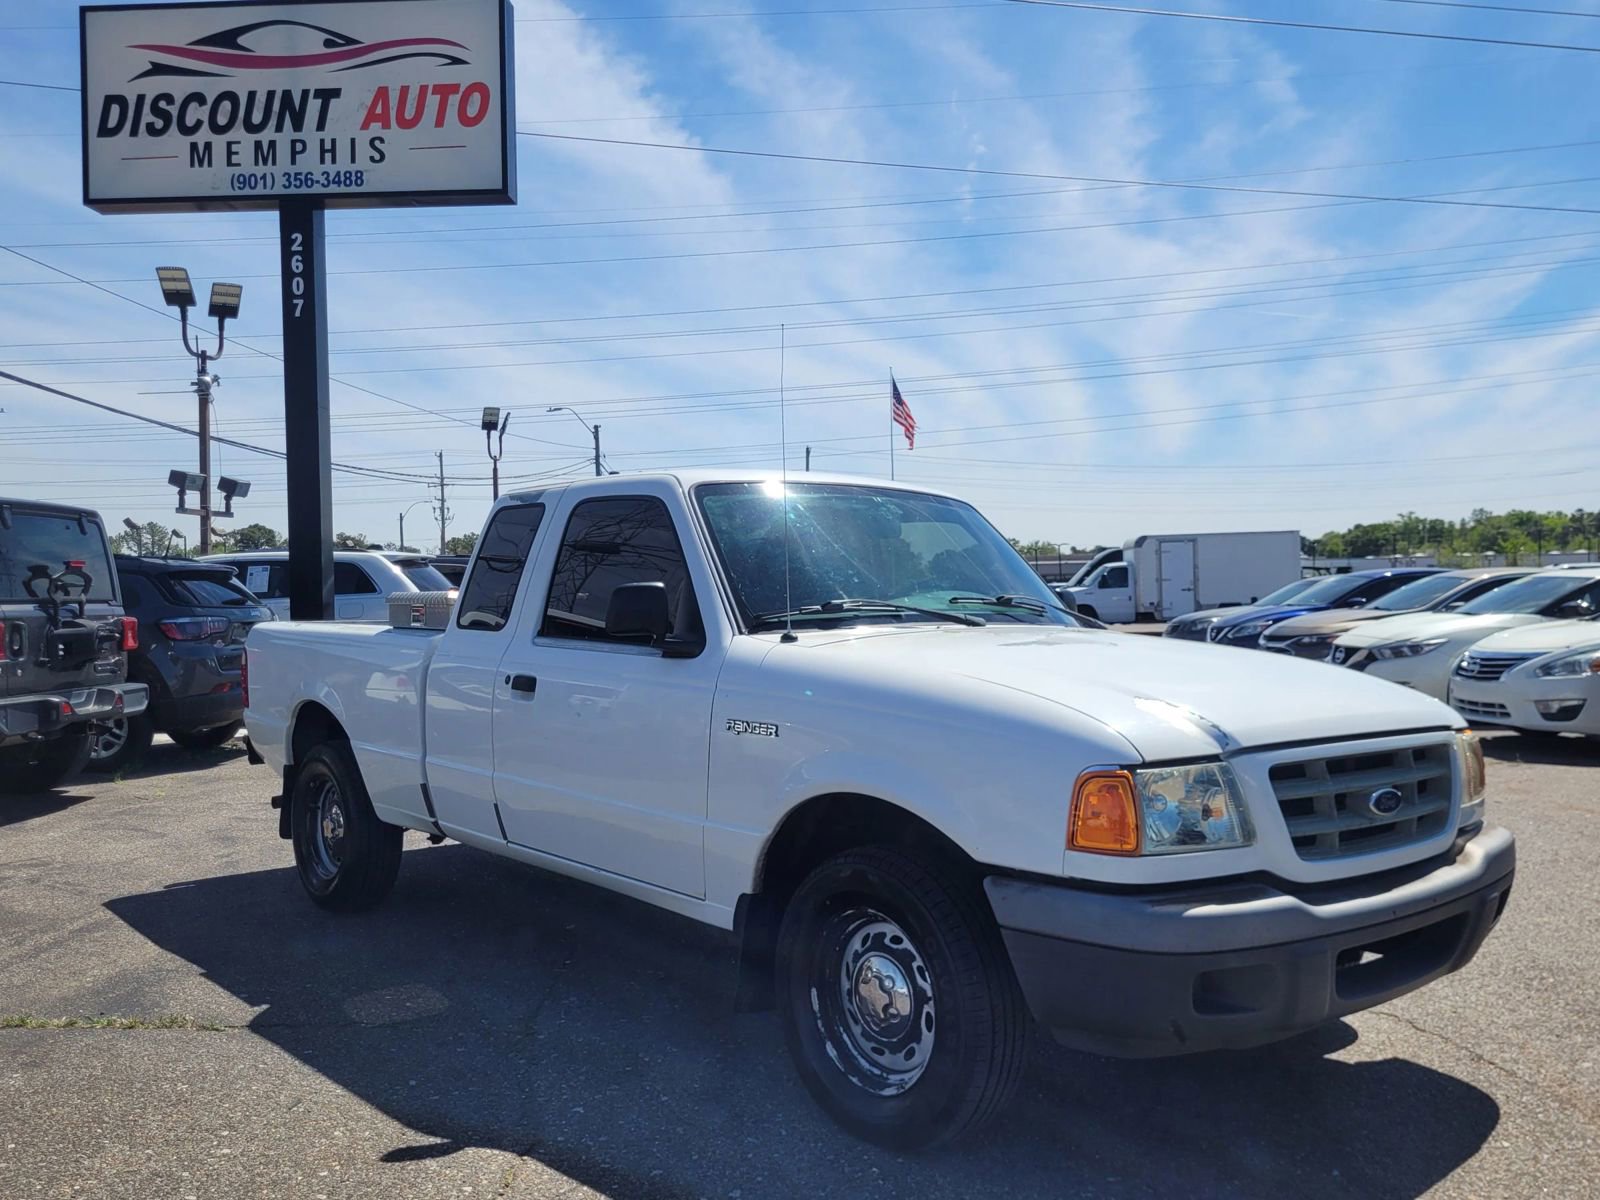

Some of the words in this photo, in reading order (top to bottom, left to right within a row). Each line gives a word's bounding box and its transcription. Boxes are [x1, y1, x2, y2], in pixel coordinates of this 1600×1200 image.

[97, 88, 342, 138] DISCOUNT
[360, 82, 490, 131] AUTO
[189, 136, 386, 168] MEMPHIS
[230, 172, 275, 191] (901)
[282, 170, 365, 190] 356-3488
[290, 233, 305, 318] 2607
[726, 718, 780, 738] RANGER
